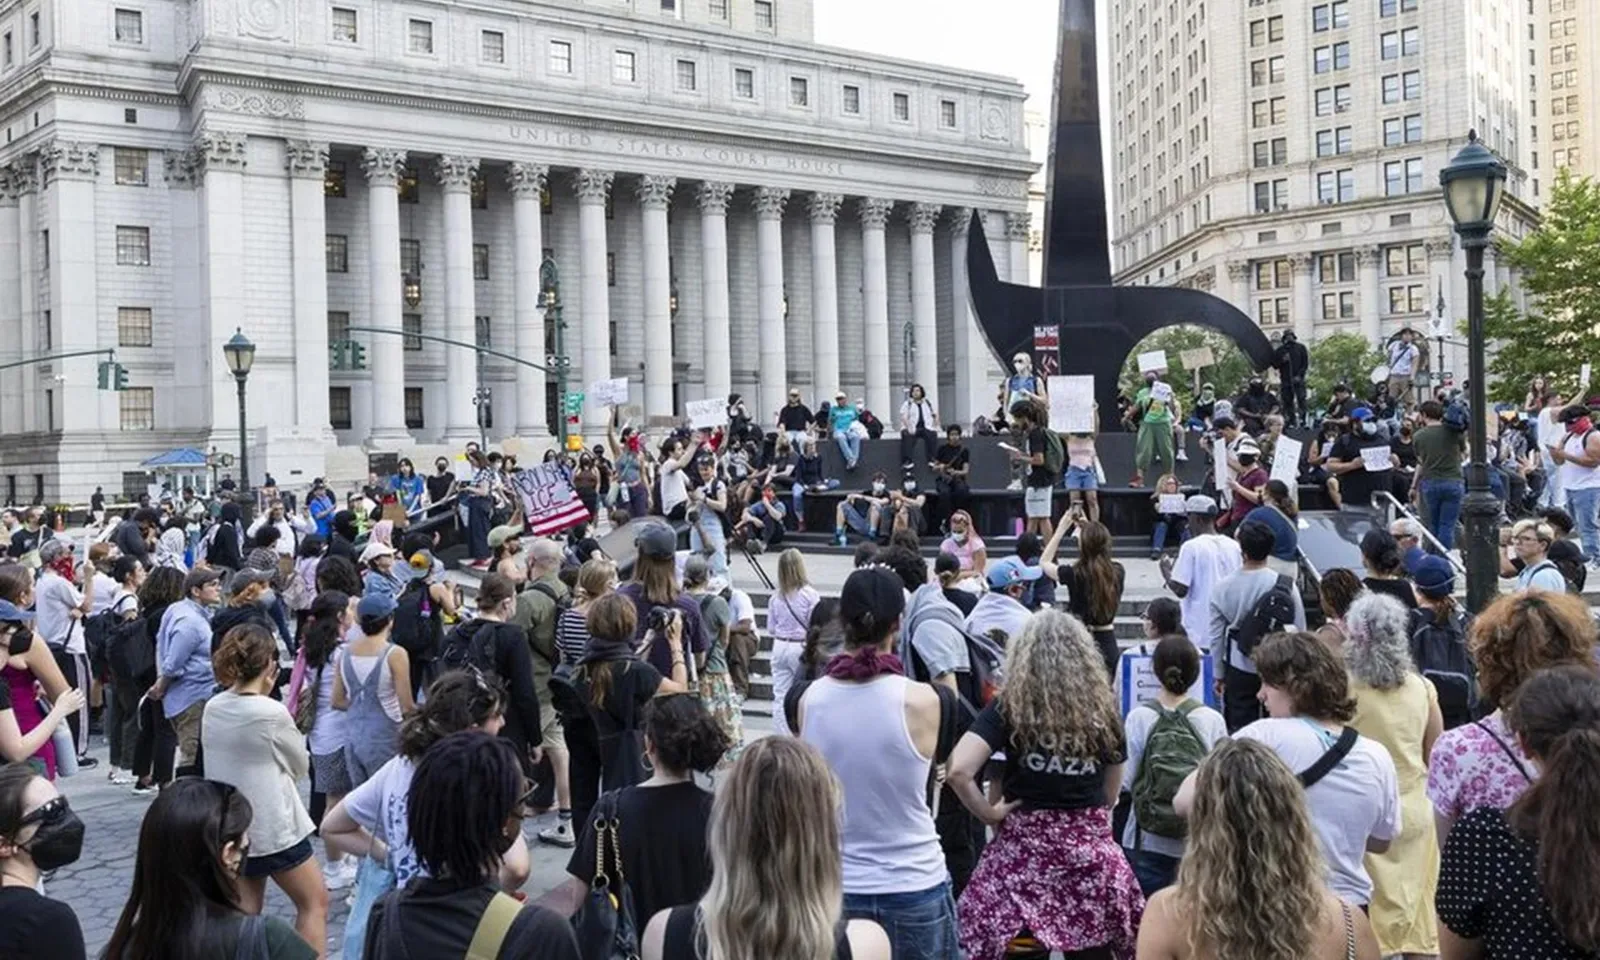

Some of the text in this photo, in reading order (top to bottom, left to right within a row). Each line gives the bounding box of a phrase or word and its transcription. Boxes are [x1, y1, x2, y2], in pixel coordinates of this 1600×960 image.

[510, 126, 845, 176] UNITED STATES COURT HOUSE
[531, 483, 563, 513] ICE
[1026, 752, 1097, 776] GAZA
